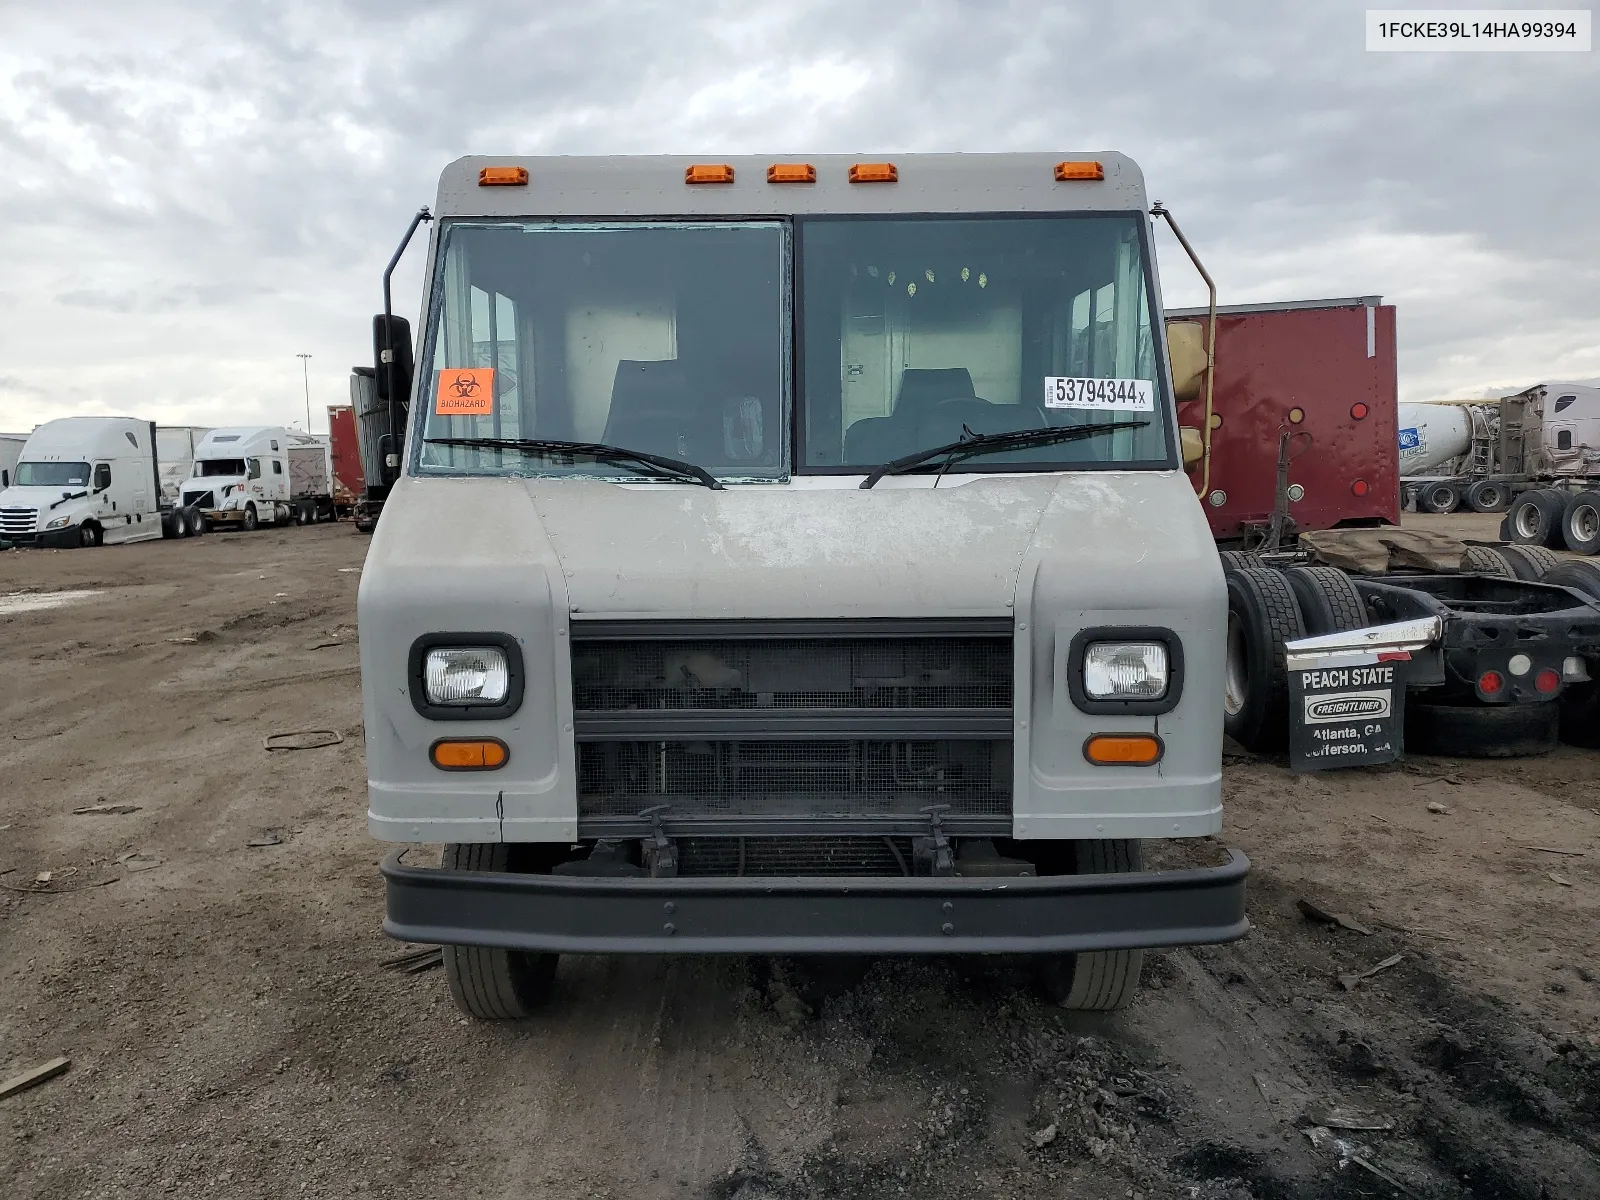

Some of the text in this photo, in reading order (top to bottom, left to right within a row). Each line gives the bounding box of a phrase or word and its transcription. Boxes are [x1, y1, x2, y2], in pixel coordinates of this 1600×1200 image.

[1056, 378, 1137, 404] 53794344
[440, 399, 486, 408] BIOHAZARD
[1302, 667, 1394, 689] PEACH STATE
[1316, 701, 1380, 715] FREIGHTLINER
[1313, 727, 1361, 741] Atlanta,
